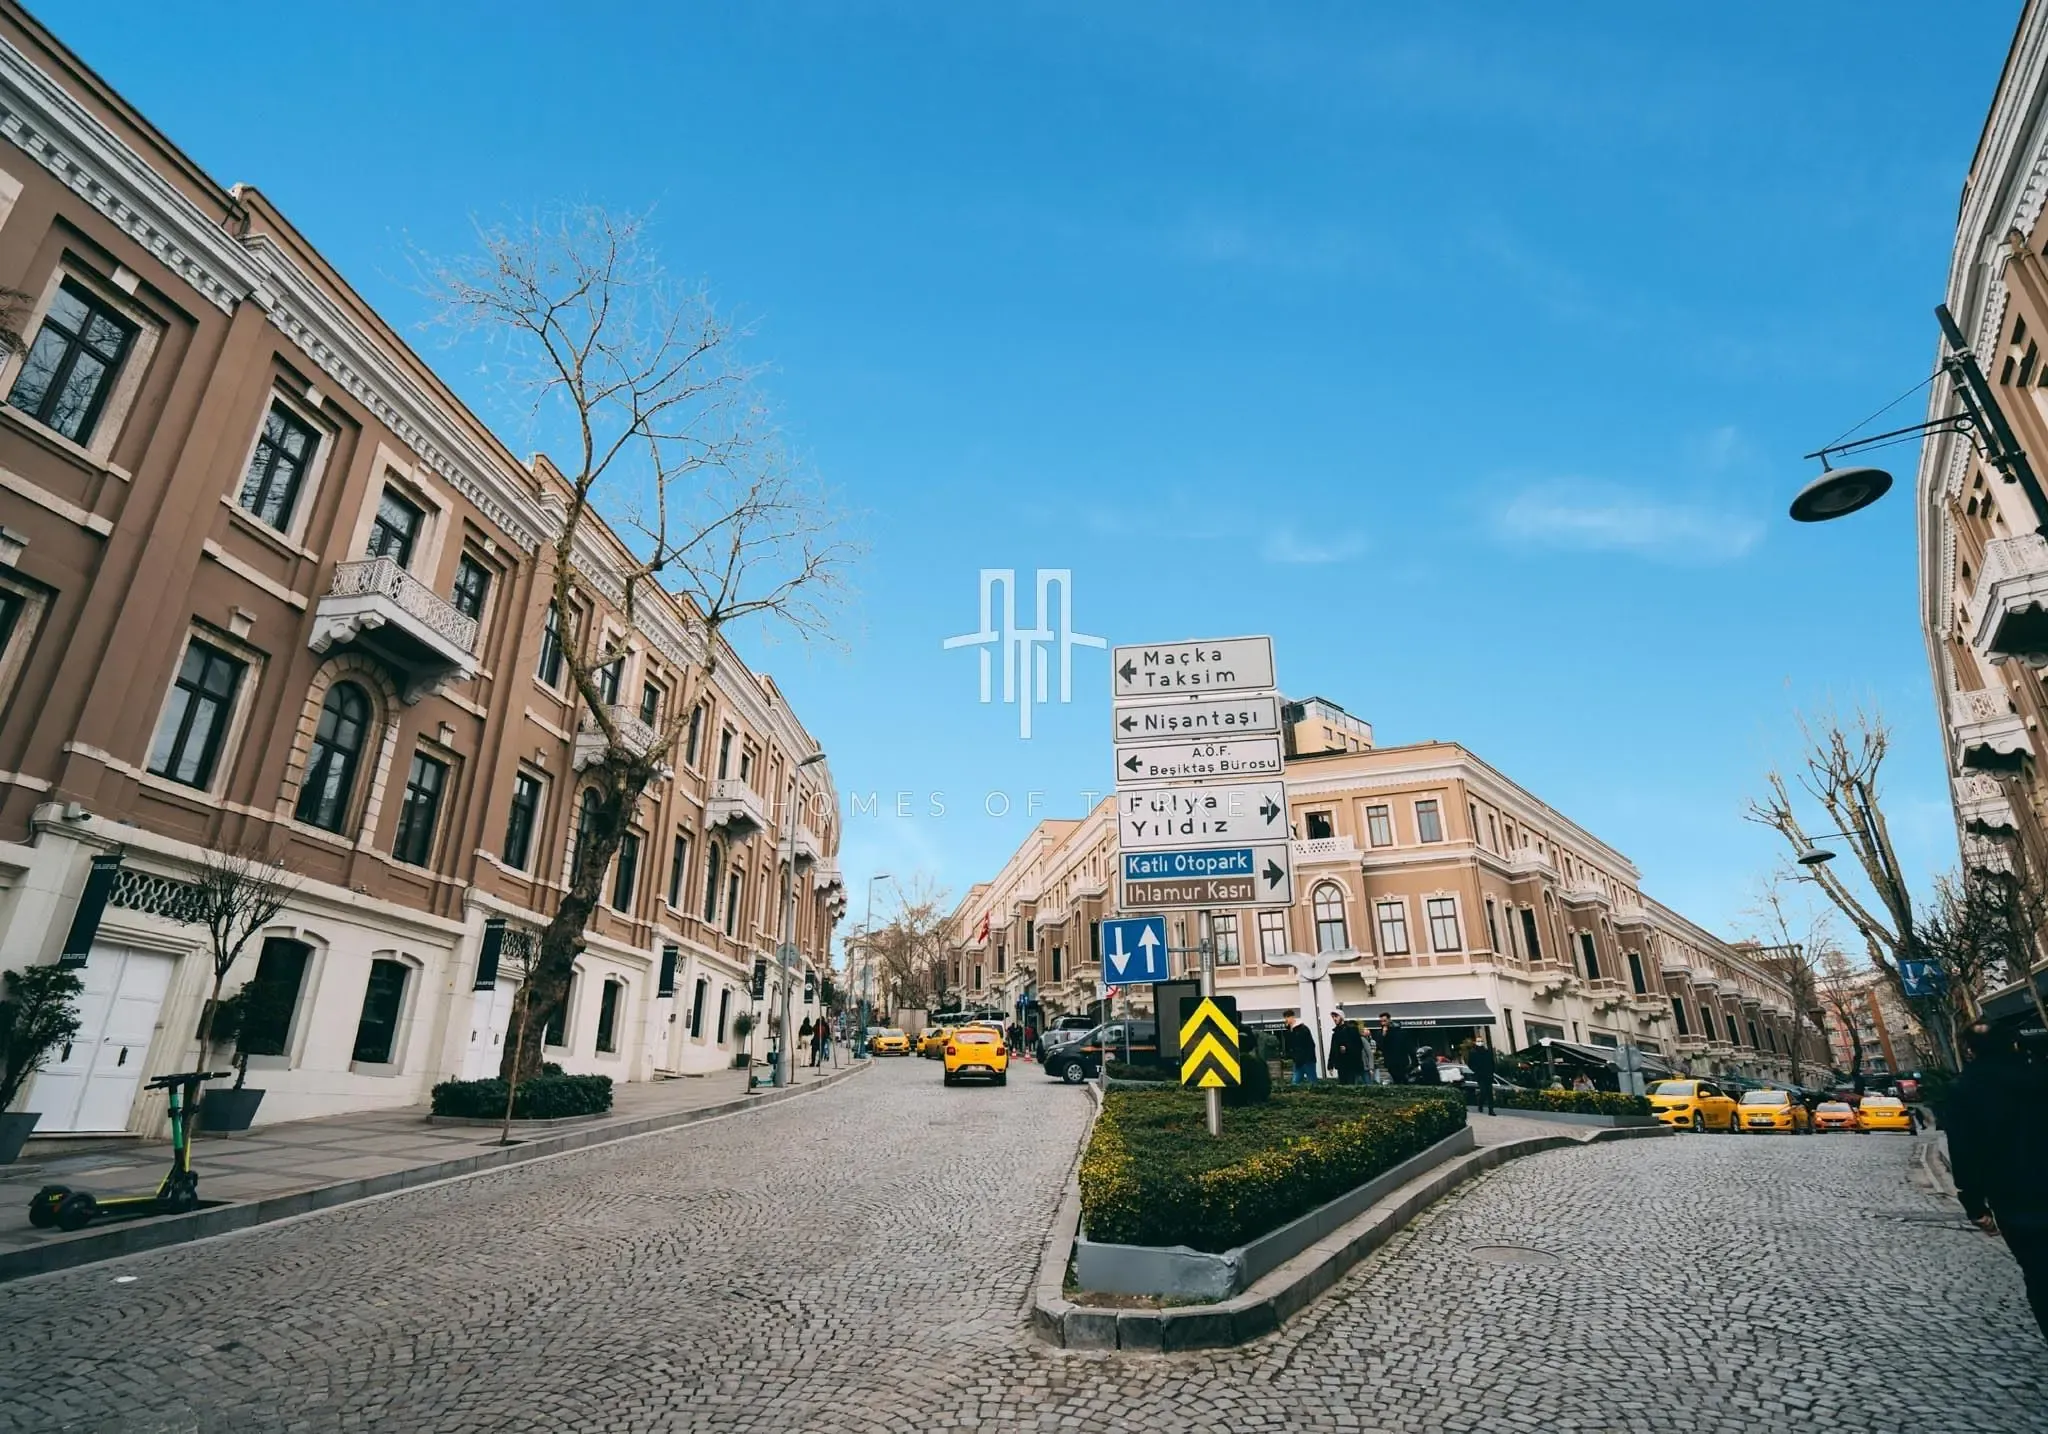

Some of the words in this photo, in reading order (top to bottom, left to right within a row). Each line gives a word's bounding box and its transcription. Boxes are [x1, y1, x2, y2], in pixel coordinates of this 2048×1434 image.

[1144, 648, 1222, 667] Maçka
[1145, 669, 1236, 688] Taksim
[1145, 711, 1258, 731] Nişantaşı
[1192, 743, 1231, 758] A.Ö.F.
[1150, 762, 1215, 776] Beşiktaş
[1220, 758, 1276, 772] Bürosu
[1130, 794, 1217, 814] Fulya
[1131, 818, 1228, 837] Yıldız
[1128, 856, 1168, 874] Katlı
[1175, 852, 1248, 874] Otopark
[1128, 883, 1201, 903] Ihlamur
[1207, 881, 1252, 899] Kasrı
